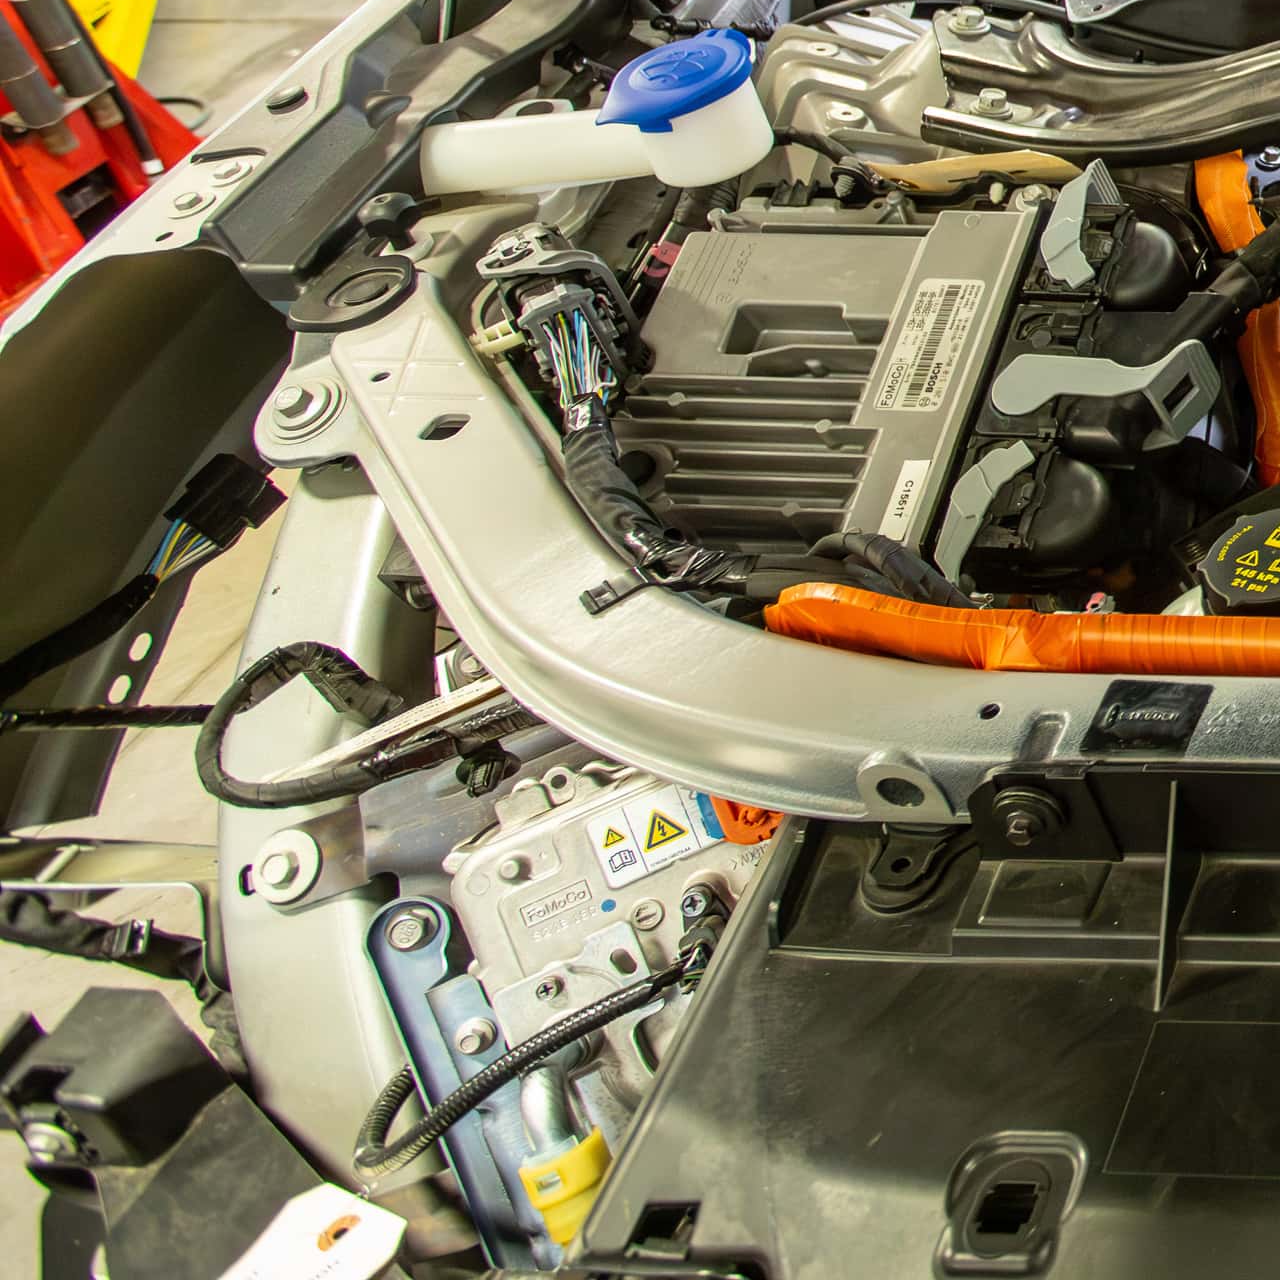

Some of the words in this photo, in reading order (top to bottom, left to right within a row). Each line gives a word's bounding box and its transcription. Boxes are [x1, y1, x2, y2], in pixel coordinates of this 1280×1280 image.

[881, 365, 904, 406] FoMoCo
[925, 362, 943, 393] BOSCH
[1231, 577, 1247, 588] 21
[1246, 582, 1269, 593] psi
[1256, 570, 1280, 585] kPa
[526, 890, 587, 922] FoMoCo
